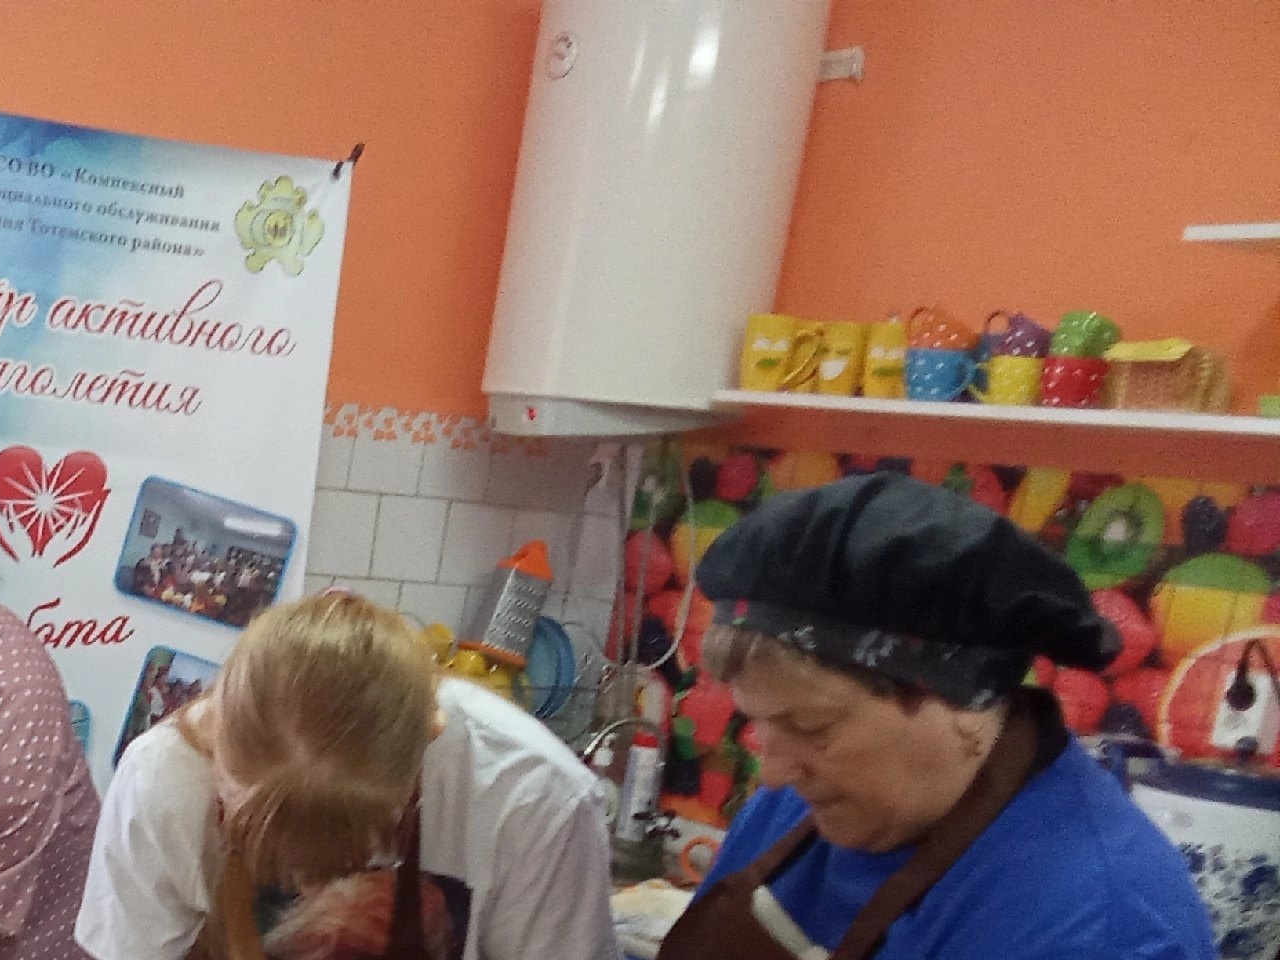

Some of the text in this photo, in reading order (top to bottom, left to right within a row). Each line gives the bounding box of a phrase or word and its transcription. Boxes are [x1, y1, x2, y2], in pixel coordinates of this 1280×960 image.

[26, 160, 55, 178] ВО
[95, 201, 221, 233] обслуживания
[28, 216, 128, 247] Тотемского
[130, 236, 206, 257] района»
[48, 279, 298, 357] активного
